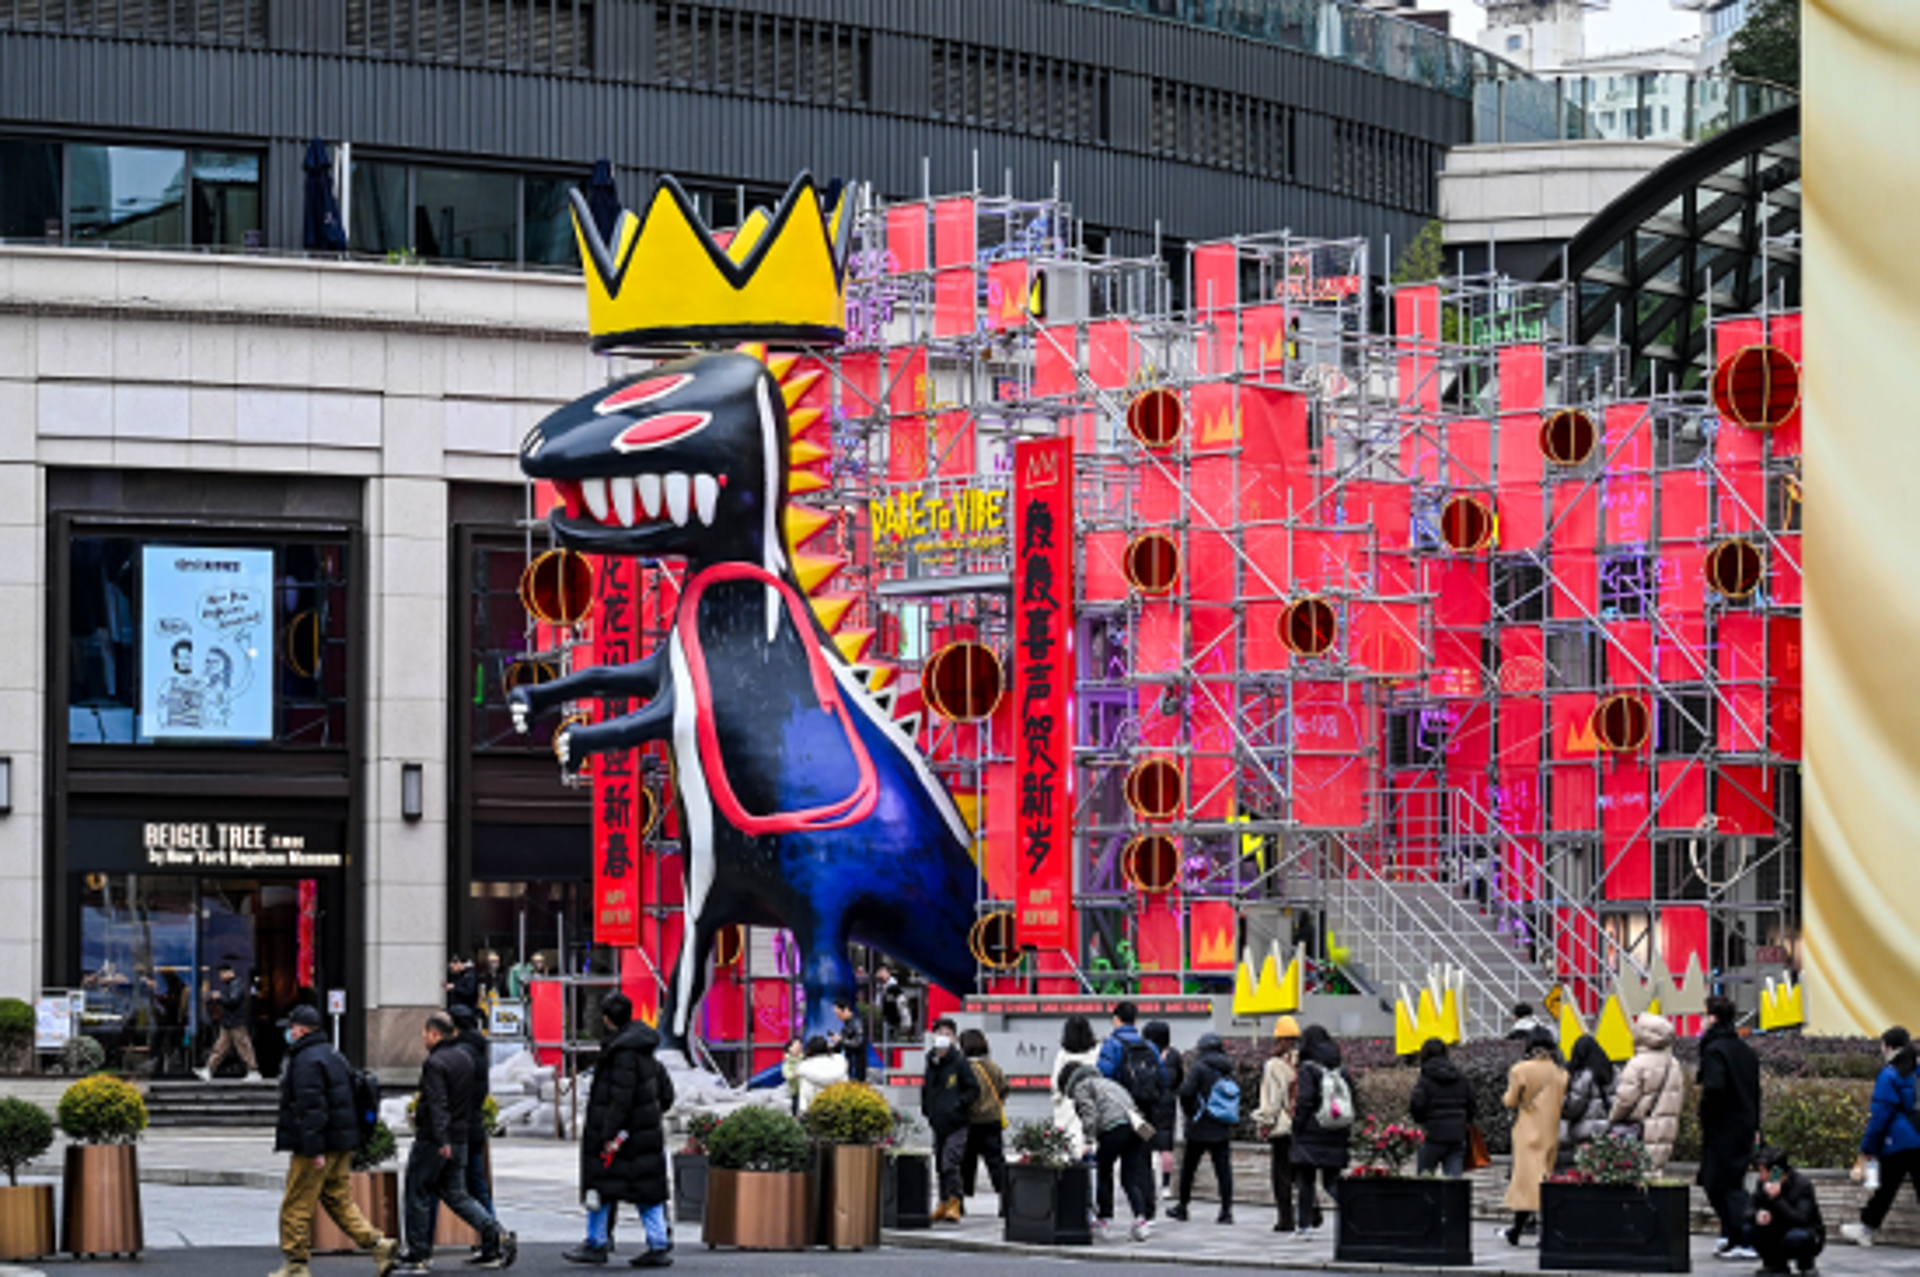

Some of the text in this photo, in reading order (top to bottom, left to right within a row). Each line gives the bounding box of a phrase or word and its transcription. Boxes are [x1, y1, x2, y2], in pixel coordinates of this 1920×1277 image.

[953, 488, 1006, 535] VIBE
[144, 823, 212, 848] BEIGEL
[216, 823, 266, 848] TREE
[198, 850, 227, 865] York
